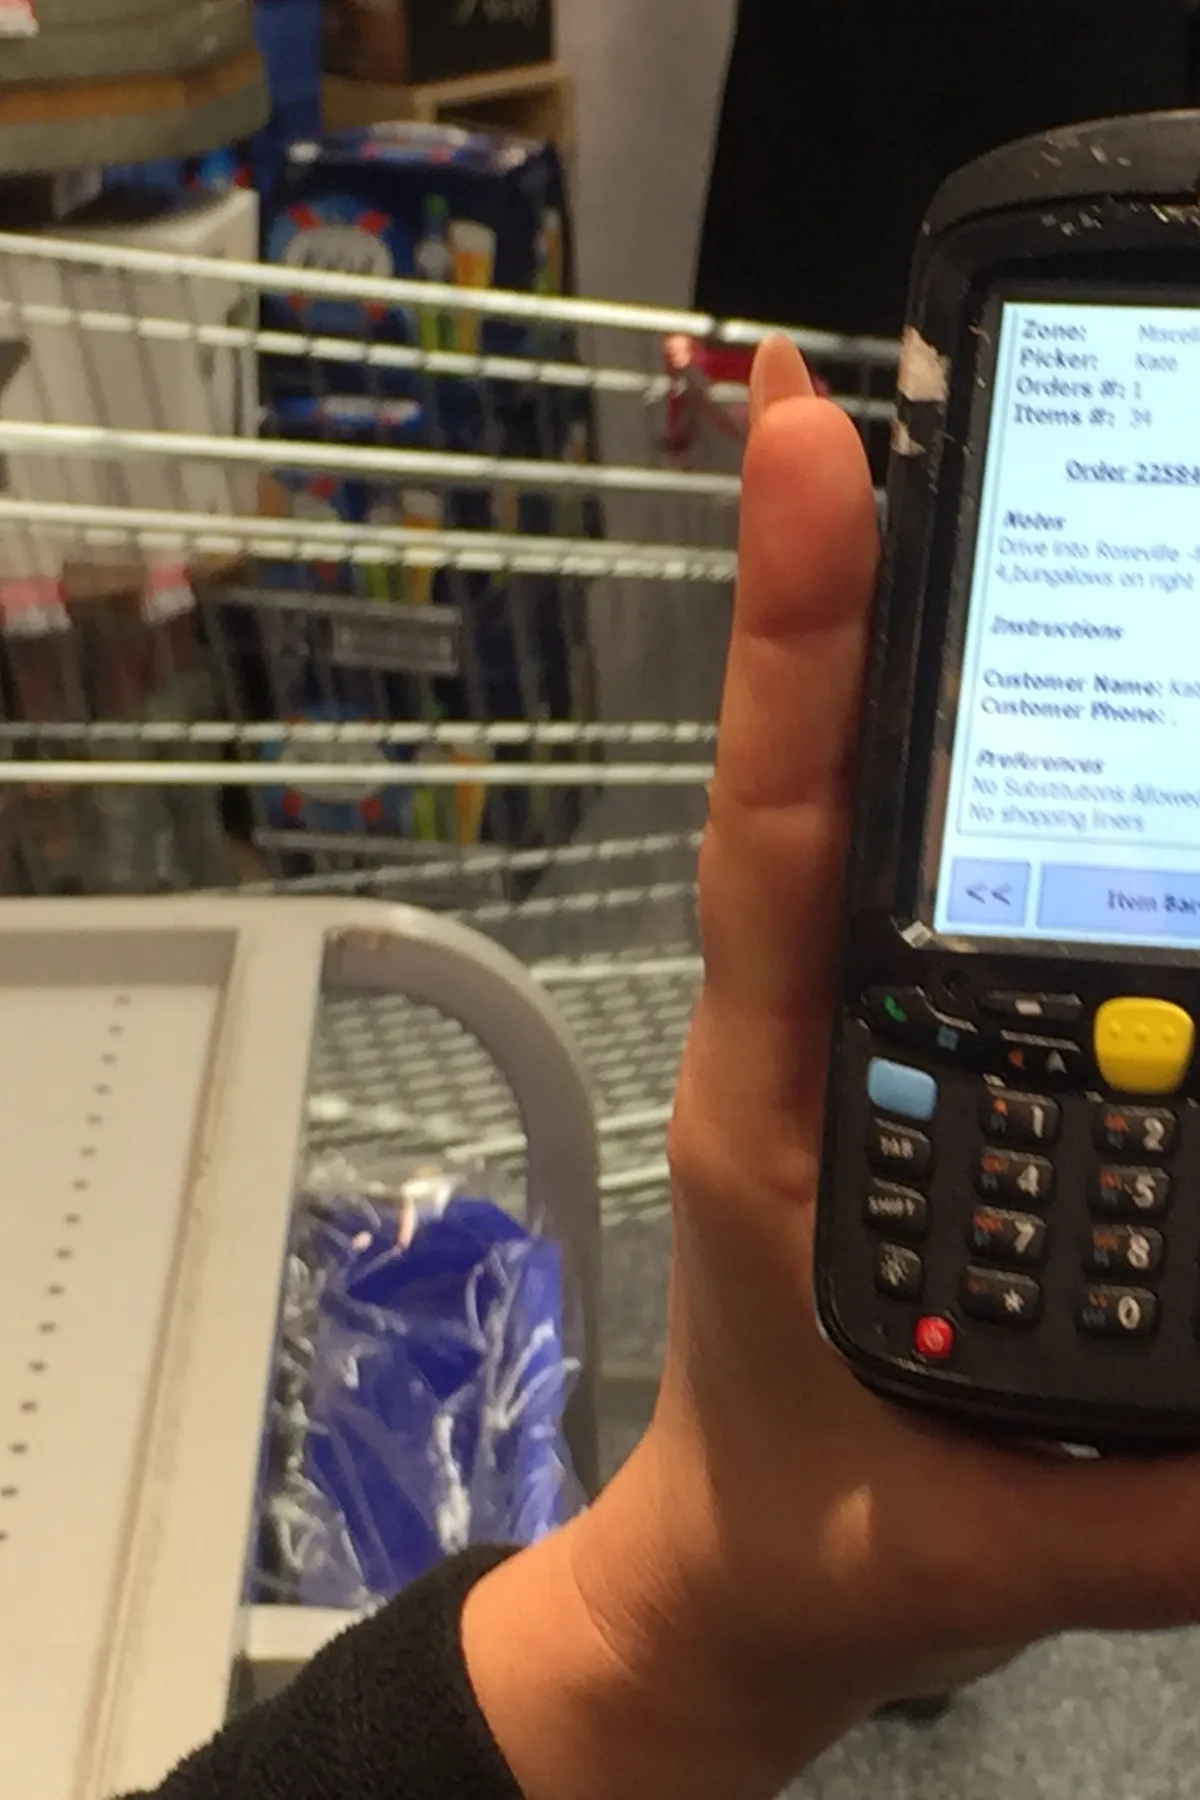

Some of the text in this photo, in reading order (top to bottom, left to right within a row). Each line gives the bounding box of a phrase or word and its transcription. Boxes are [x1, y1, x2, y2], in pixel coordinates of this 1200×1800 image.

[1022, 318, 1087, 342] Zone:
[1020, 347, 1178, 373] Picker: Kate
[1016, 375, 1093, 397] Orders
[1014, 402, 1083, 426] Items
[1065, 459, 1127, 482] Order
[1003, 510, 1066, 531] Notes
[999, 536, 1048, 557] Drive
[1053, 541, 1090, 560] into
[1119, 571, 1144, 588] on
[1150, 571, 1194, 593] right
[990, 615, 1125, 641] Instructions
[982, 668, 1085, 693] Customer
[1093, 673, 1164, 697] Name:
[980, 696, 1085, 720] Customer
[1090, 699, 1166, 725] Phone:
[976, 749, 1105, 775] Preferences
[972, 776, 998, 795] No
[969, 802, 995, 822] No
[1106, 888, 1159, 913] Item
[1143, 1116, 1165, 1152] 2
[1016, 1163, 1040, 1197] 4
[1133, 1173, 1156, 1209] 5
[1014, 1218, 1036, 1254] 7
[1127, 1232, 1150, 1269] 8
[1117, 1295, 1141, 1330] 0
